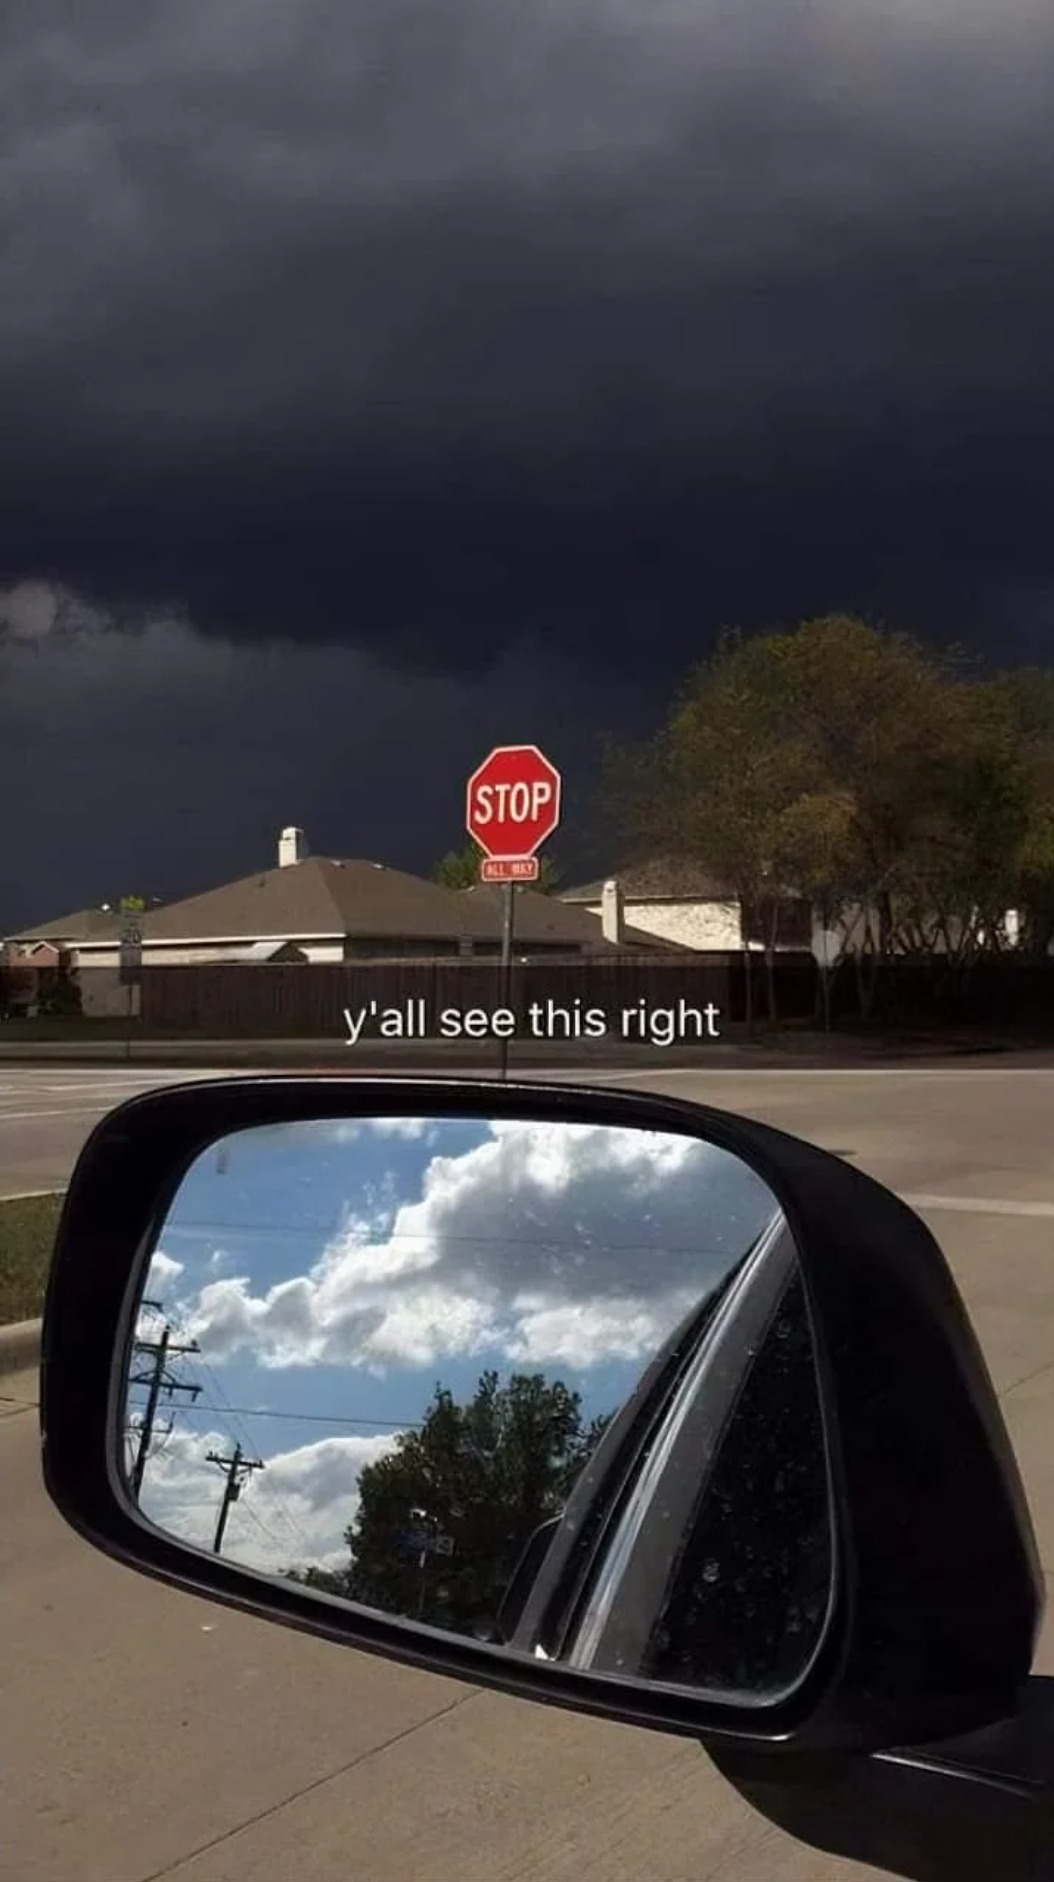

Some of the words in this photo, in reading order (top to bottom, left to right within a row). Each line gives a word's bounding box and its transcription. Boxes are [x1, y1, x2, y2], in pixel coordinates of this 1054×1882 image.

[474, 783, 551, 824] STOP
[486, 863, 504, 876] ALL
[512, 862, 533, 875] WAY
